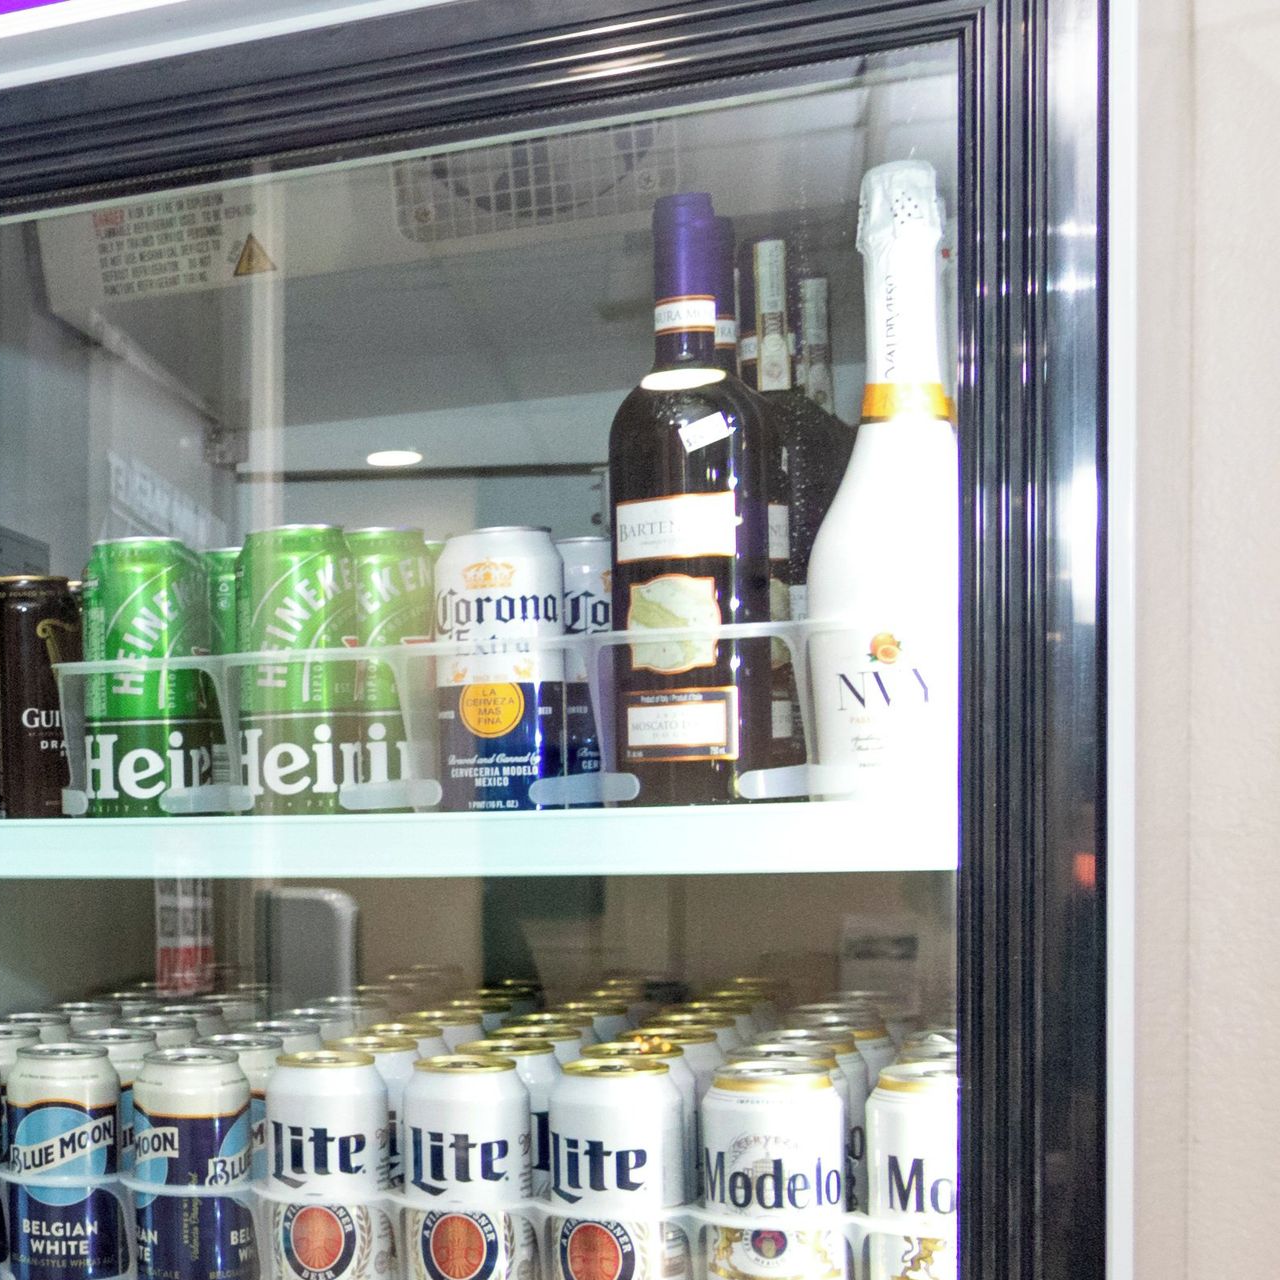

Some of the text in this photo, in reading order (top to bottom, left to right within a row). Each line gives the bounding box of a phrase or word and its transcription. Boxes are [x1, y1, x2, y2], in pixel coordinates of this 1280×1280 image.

[436, 588, 559, 640] Corona
[481, 688, 497, 697] LA
[477, 715, 503, 726] FINA
[11, 1120, 115, 1174] BLUE MOON
[271, 1120, 367, 1189] Lite
[410, 1126, 510, 1197] Lite
[551, 1130, 648, 1204] Lite
[704, 1147, 842, 1211] Modelo
[22, 1218, 99, 1238] BELGIAN
[30, 1238, 90, 1256] WHITE
